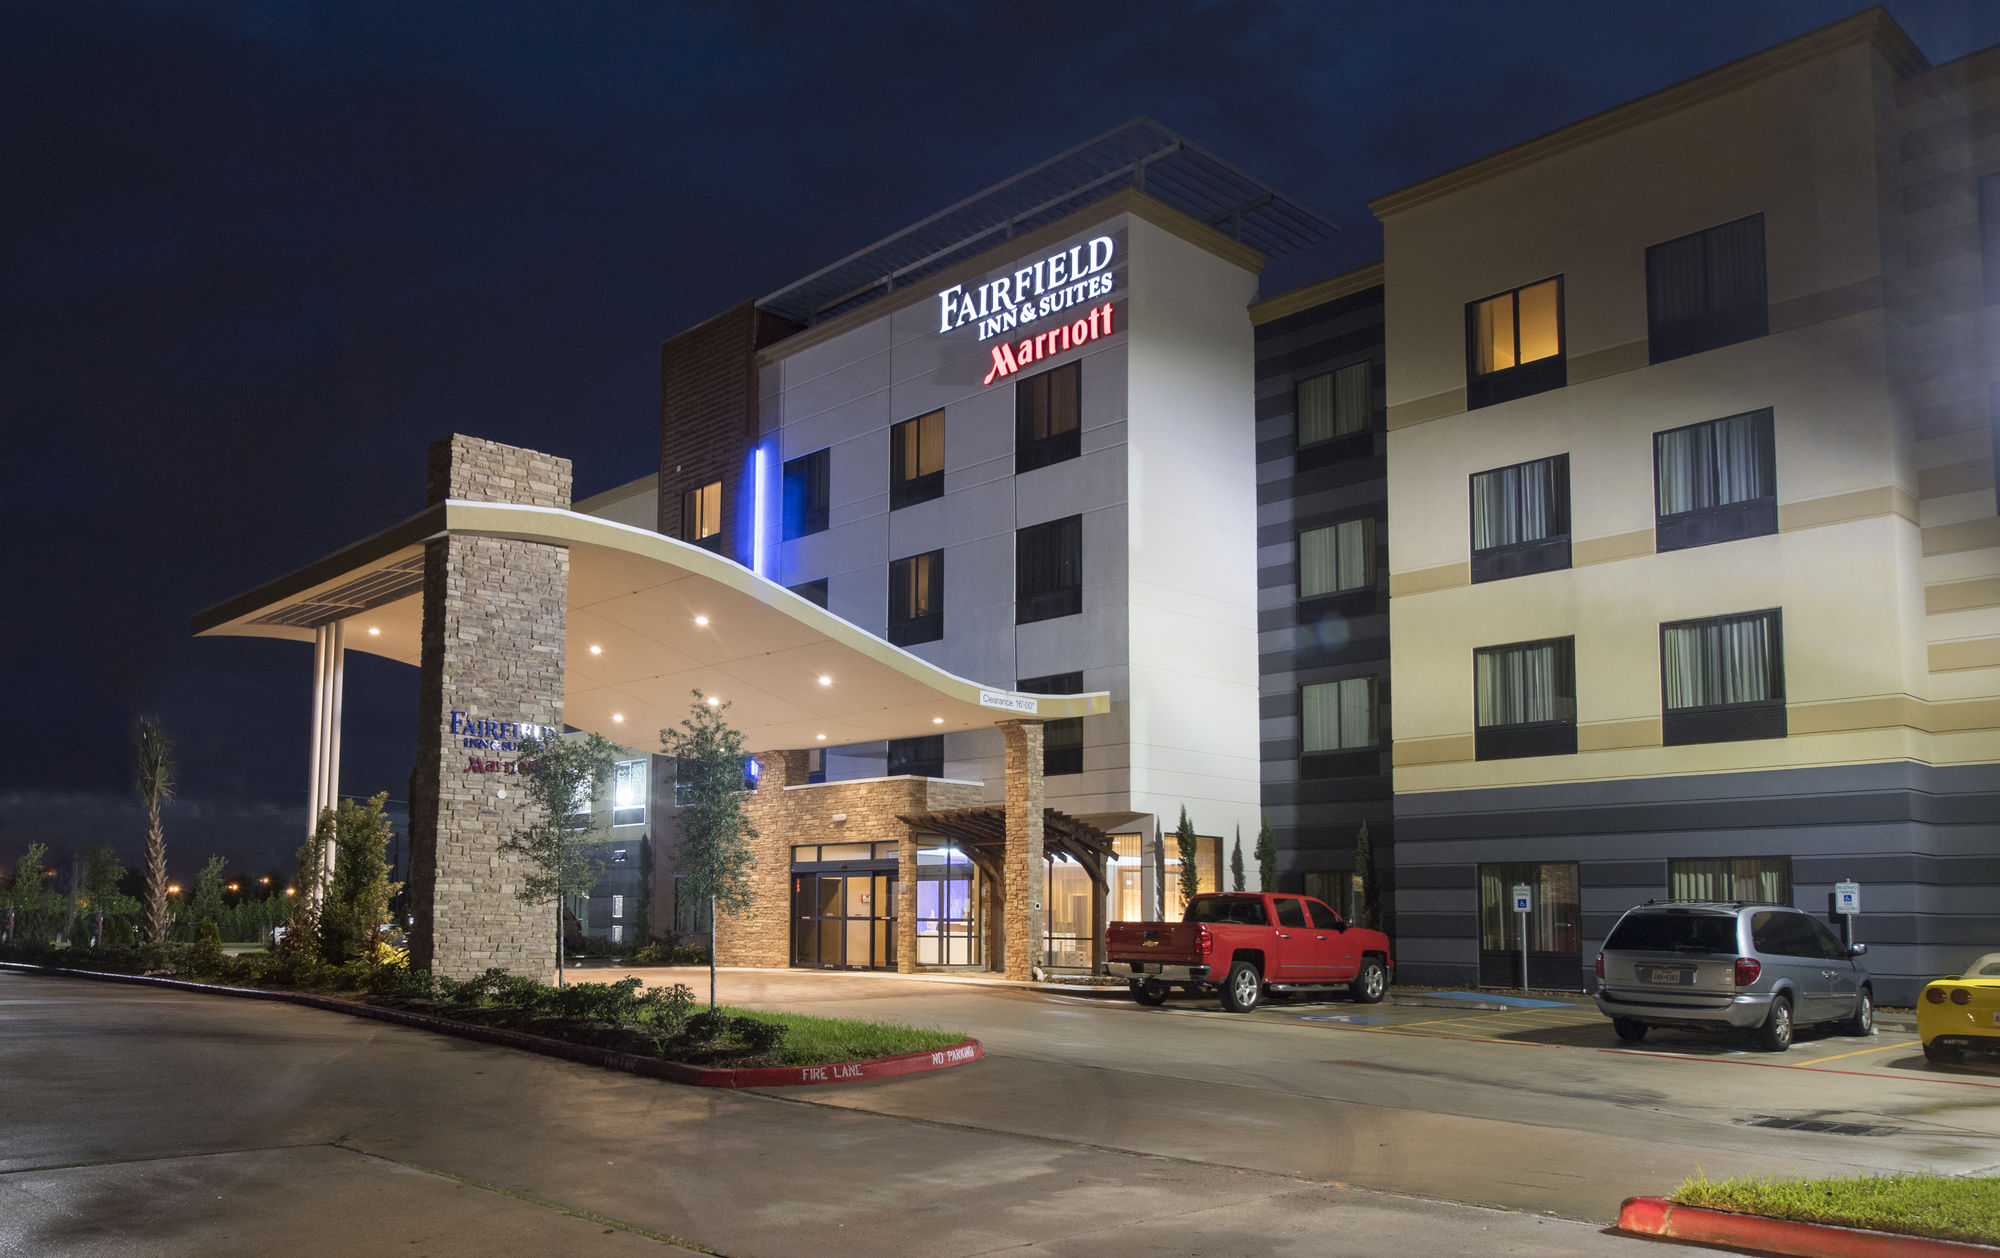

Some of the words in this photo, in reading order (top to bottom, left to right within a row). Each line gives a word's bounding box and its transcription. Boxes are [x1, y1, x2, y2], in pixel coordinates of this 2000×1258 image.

[938, 236, 1114, 334] FAIRFIELD
[978, 307, 1019, 342] INN
[1019, 302, 1038, 324] &
[1039, 272, 1113, 317] SUITES
[983, 301, 1114, 385] Marriott
[982, 694, 1014, 707] Clearance
[450, 710, 558, 743] FAIRFIELD
[463, 737, 490, 750] INN
[931, 1052, 945, 1065] NO
[948, 1045, 975, 1062] PARKING
[802, 1067, 828, 1081] FIRE
[833, 1064, 863, 1079] LANE
